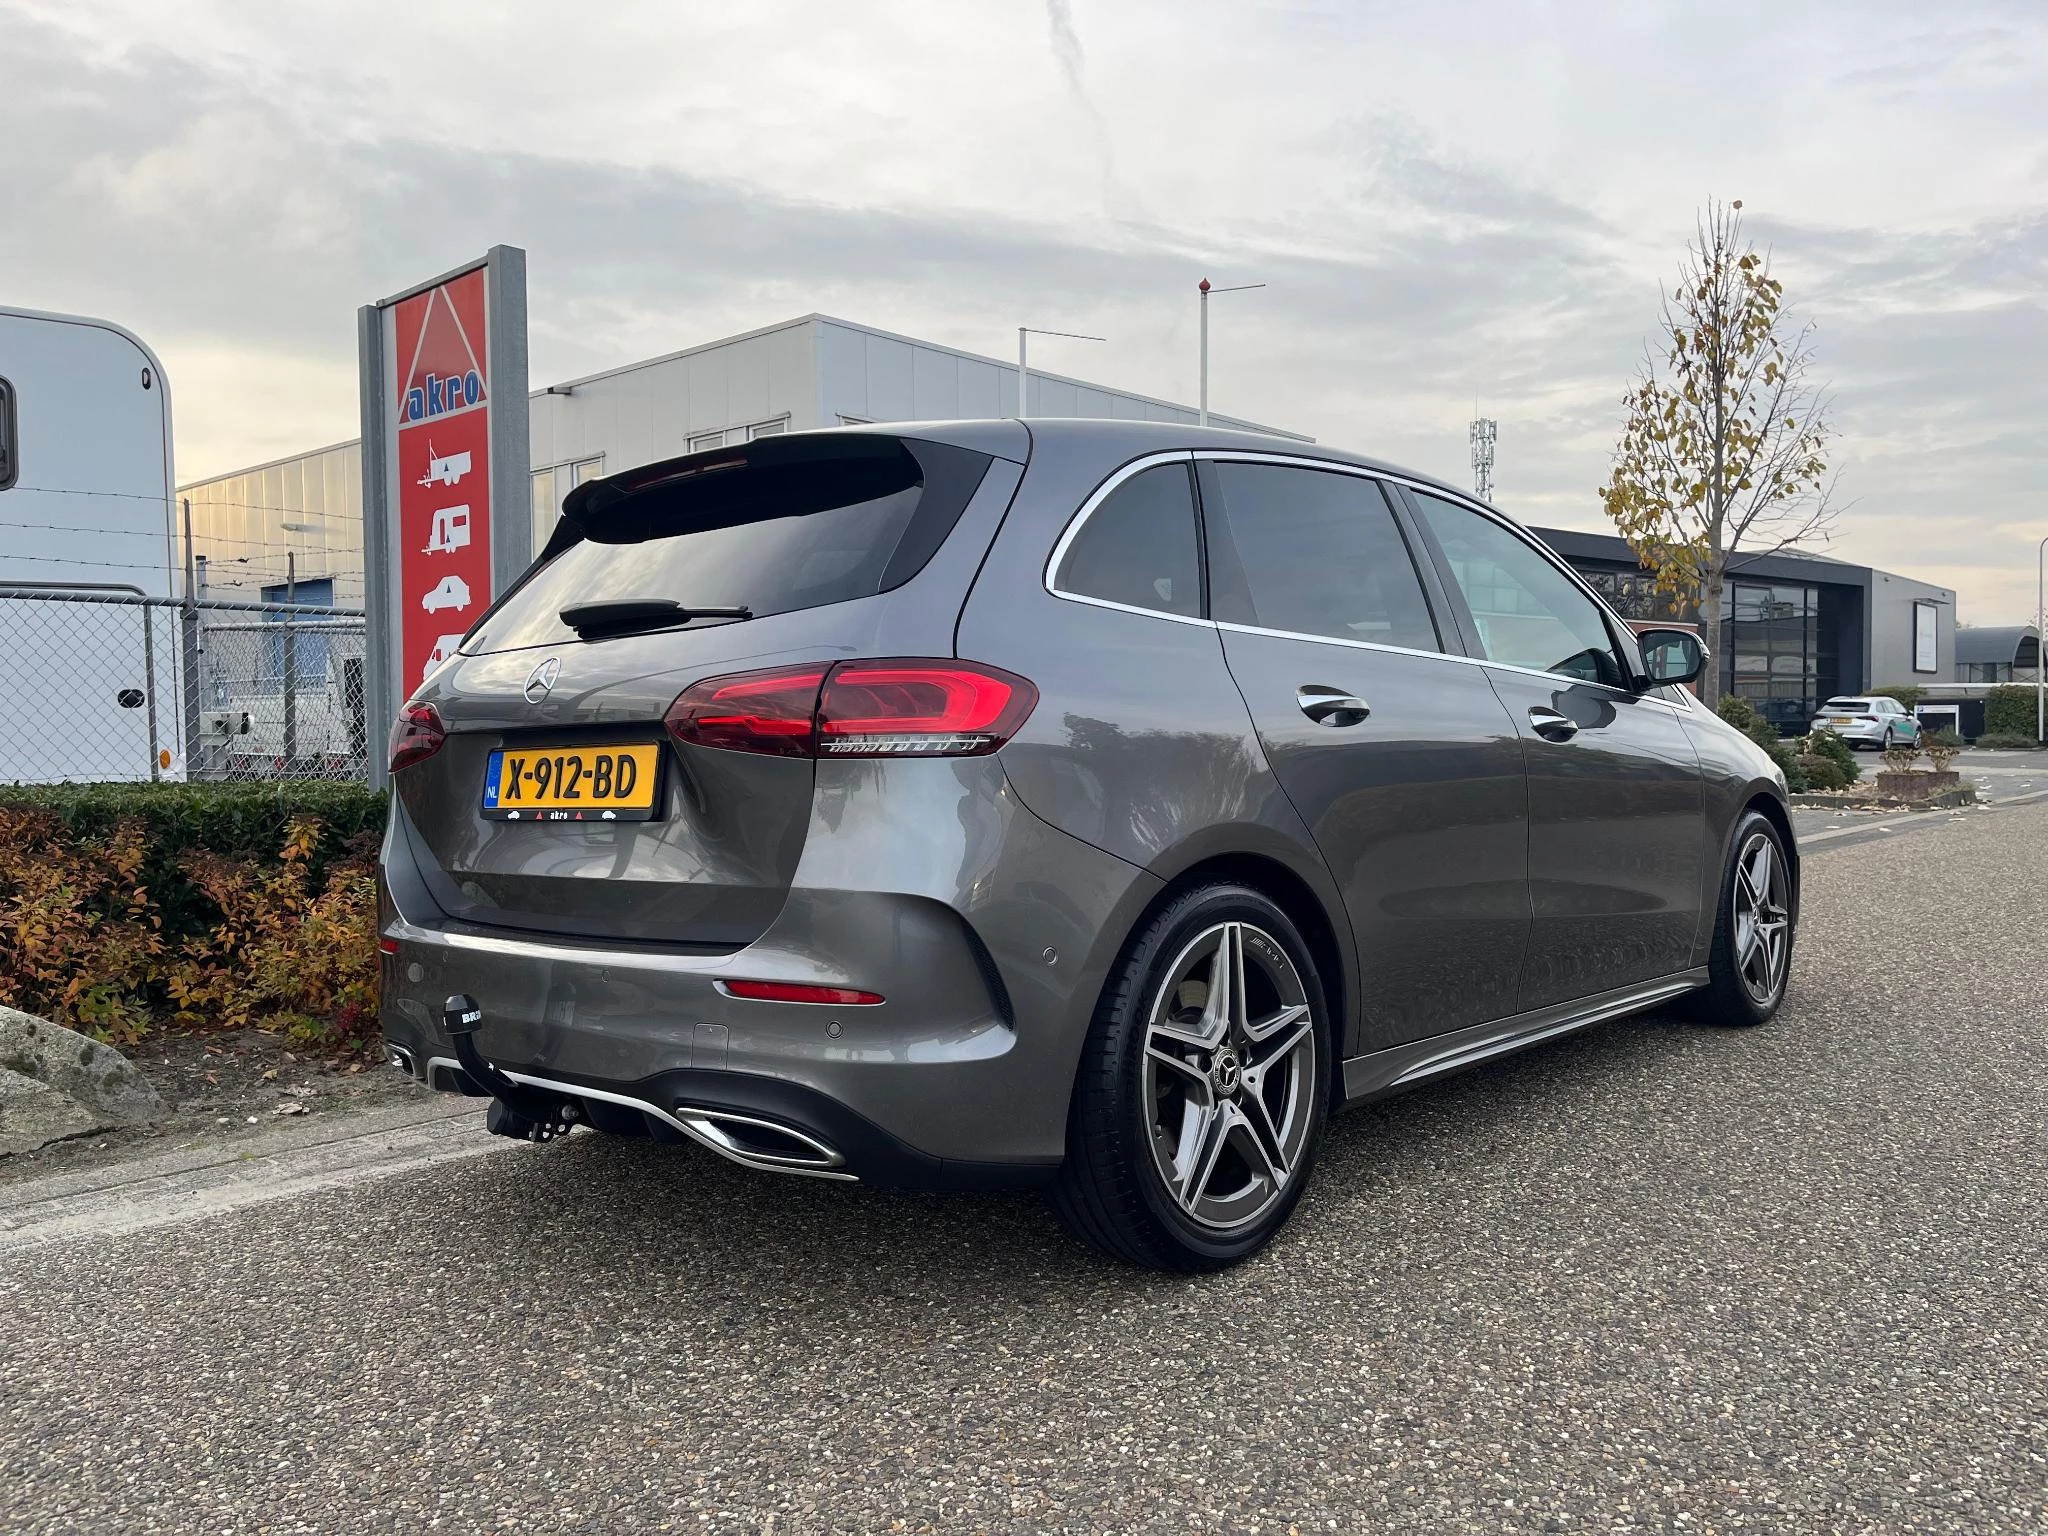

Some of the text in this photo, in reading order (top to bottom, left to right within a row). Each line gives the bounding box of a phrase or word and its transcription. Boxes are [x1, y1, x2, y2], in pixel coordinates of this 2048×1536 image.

[408, 369, 479, 421] akro
[505, 755, 636, 799] X-912-BD
[487, 786, 497, 799] NL
[550, 811, 568, 820] akro
